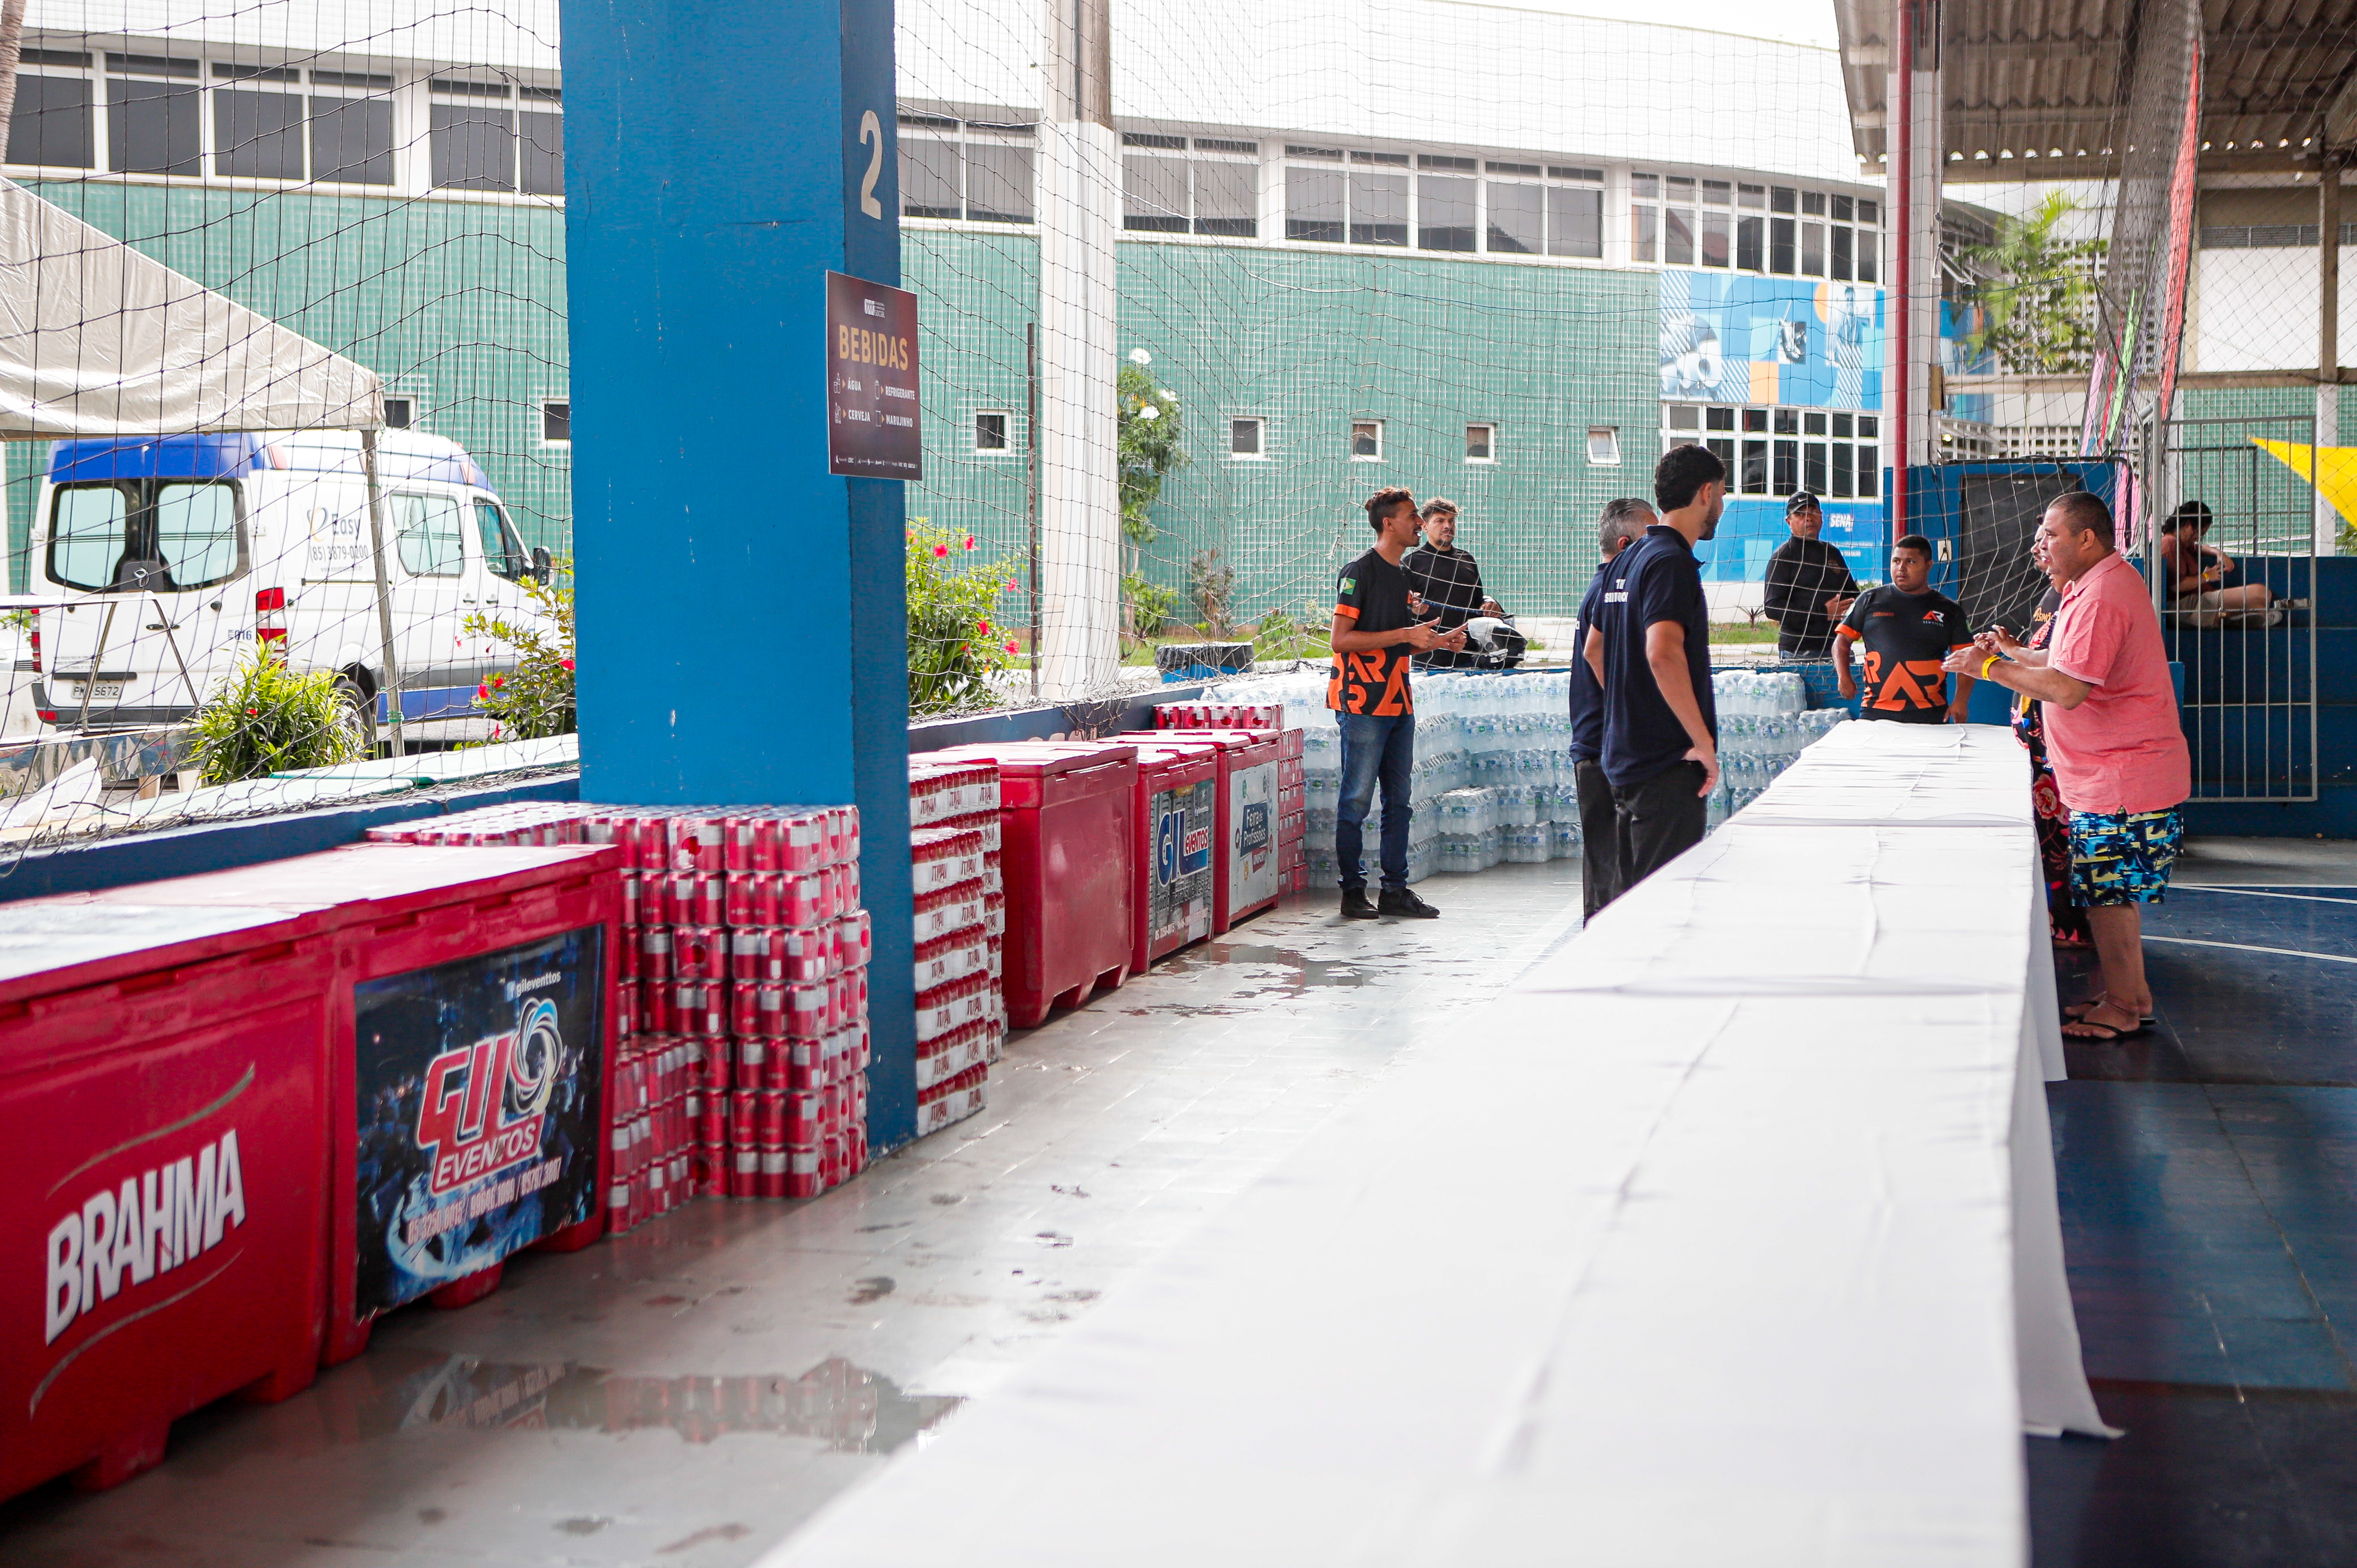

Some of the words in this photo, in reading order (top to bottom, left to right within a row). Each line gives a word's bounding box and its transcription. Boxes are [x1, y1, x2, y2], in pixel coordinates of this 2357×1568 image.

[859, 109, 882, 220] 2
[839, 324, 909, 371] BEBIDAS
[848, 377, 862, 392] ÁGUA
[885, 386, 915, 400] REFRIGERANTE
[849, 409, 871, 422] CERVEJA
[886, 414, 913, 427] MARUJINHO
[332, 513, 360, 540] Easy
[310, 546, 326, 563] (85)
[1922, 610, 1945, 623] AR
[235, 630, 252, 640] 016
[1872, 659, 1946, 712] AR
[1246, 807, 1259, 827] Feira
[1156, 807, 1209, 887] GIL
[1244, 825, 1266, 847] Profissões
[516, 971, 561, 998] gileventtos
[418, 1031, 546, 1149] GIL
[436, 1122, 537, 1189] EVENTOS
[45, 1127, 246, 1347] BRAHMA
